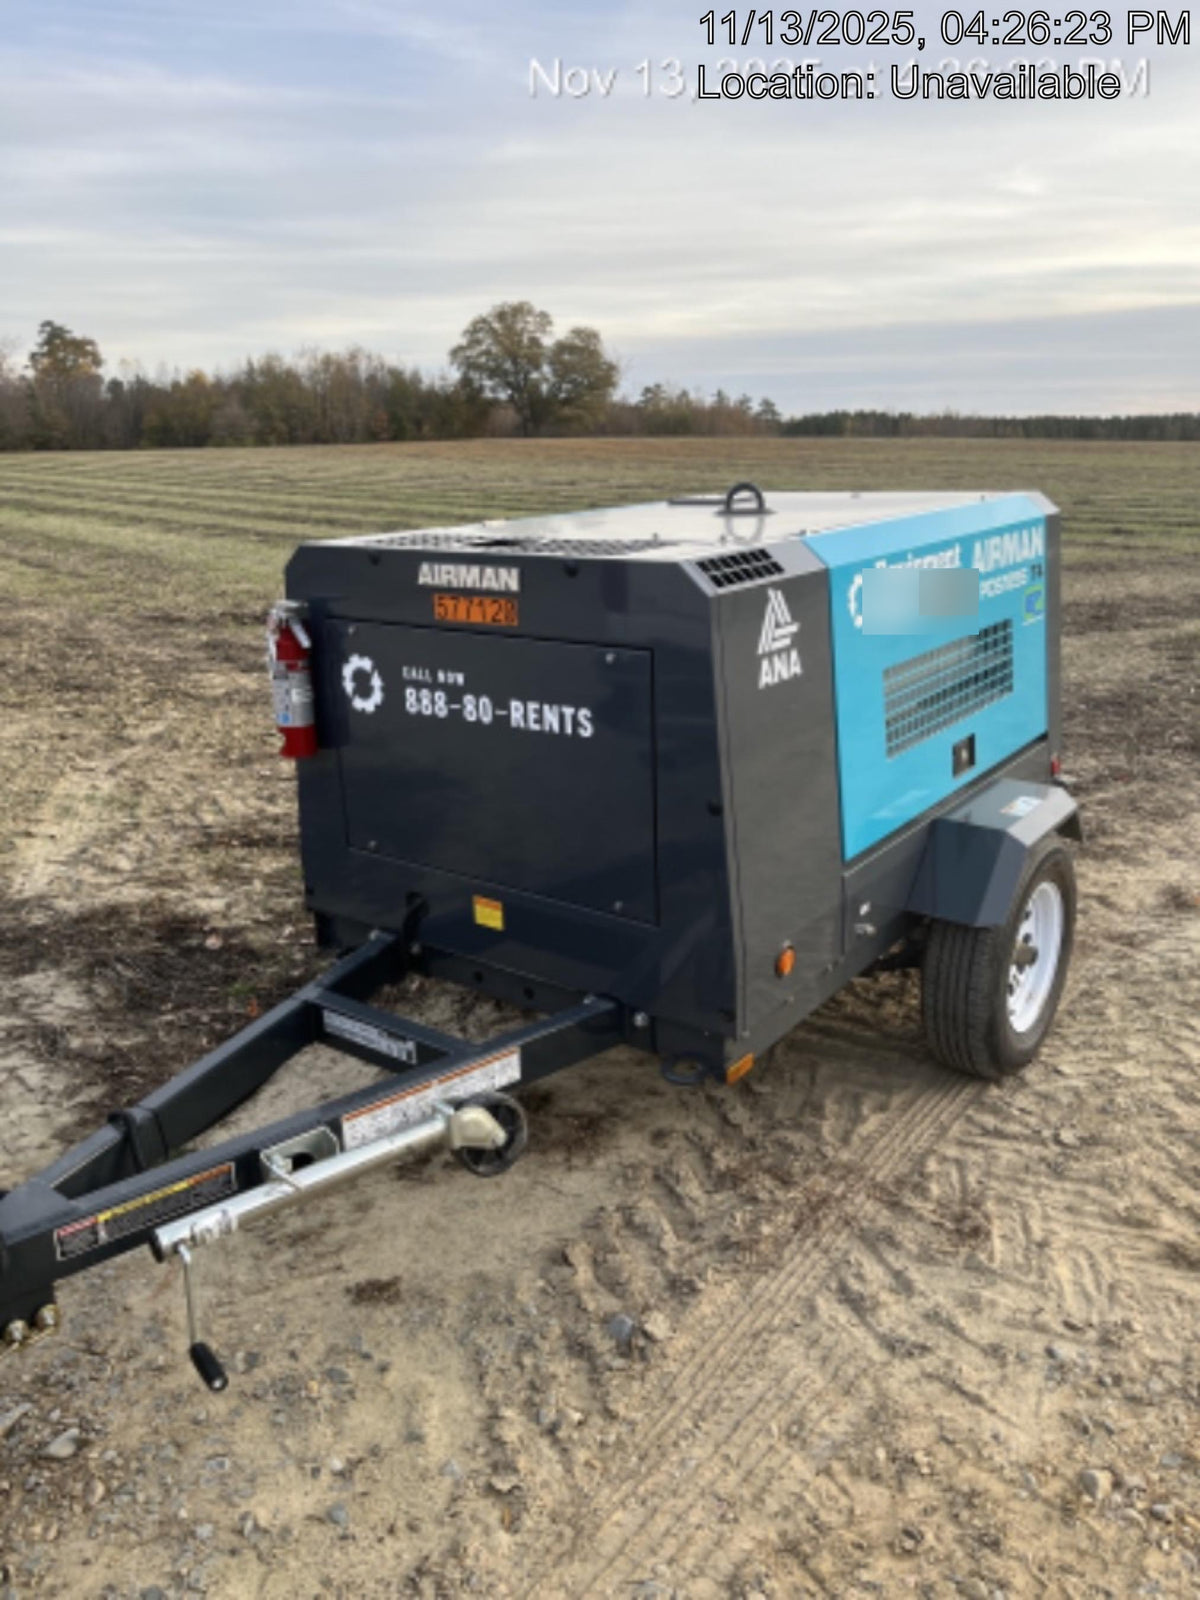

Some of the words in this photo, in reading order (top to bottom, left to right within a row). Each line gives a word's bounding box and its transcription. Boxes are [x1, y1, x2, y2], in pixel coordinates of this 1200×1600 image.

[971, 526, 1045, 573] AIRMAN
[418, 561, 520, 592] AIRMAN
[402, 665, 433, 684] CALL
[437, 669, 465, 687] NOW
[758, 648, 803, 689] ANA
[405, 686, 594, 739] 888-80-RENTS
